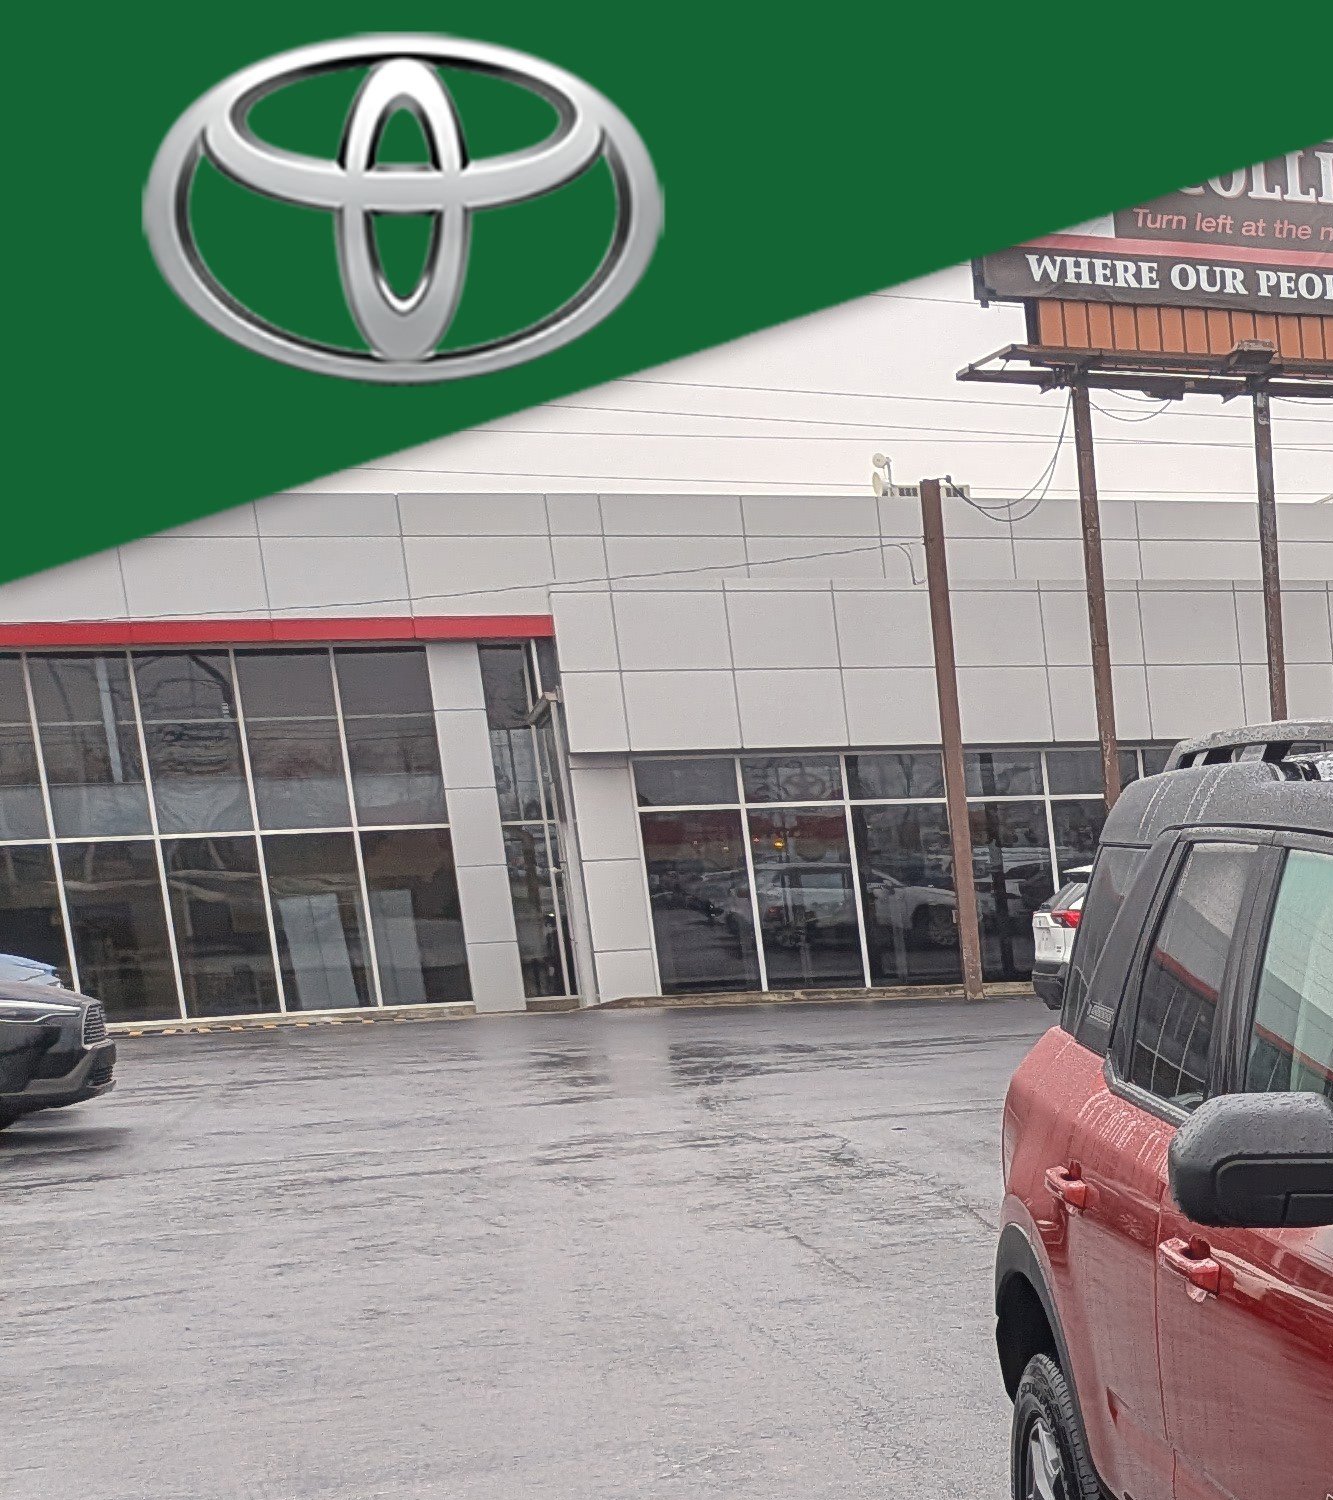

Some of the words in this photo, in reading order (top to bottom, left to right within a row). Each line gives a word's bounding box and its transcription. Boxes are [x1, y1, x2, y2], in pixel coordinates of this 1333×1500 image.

[1132, 208, 1187, 231] Turn
[1195, 212, 1234, 235] left
[1241, 217, 1266, 237] at
[1273, 218, 1312, 240] the
[1025, 254, 1161, 290] WHERE
[1170, 263, 1249, 296] OUR
